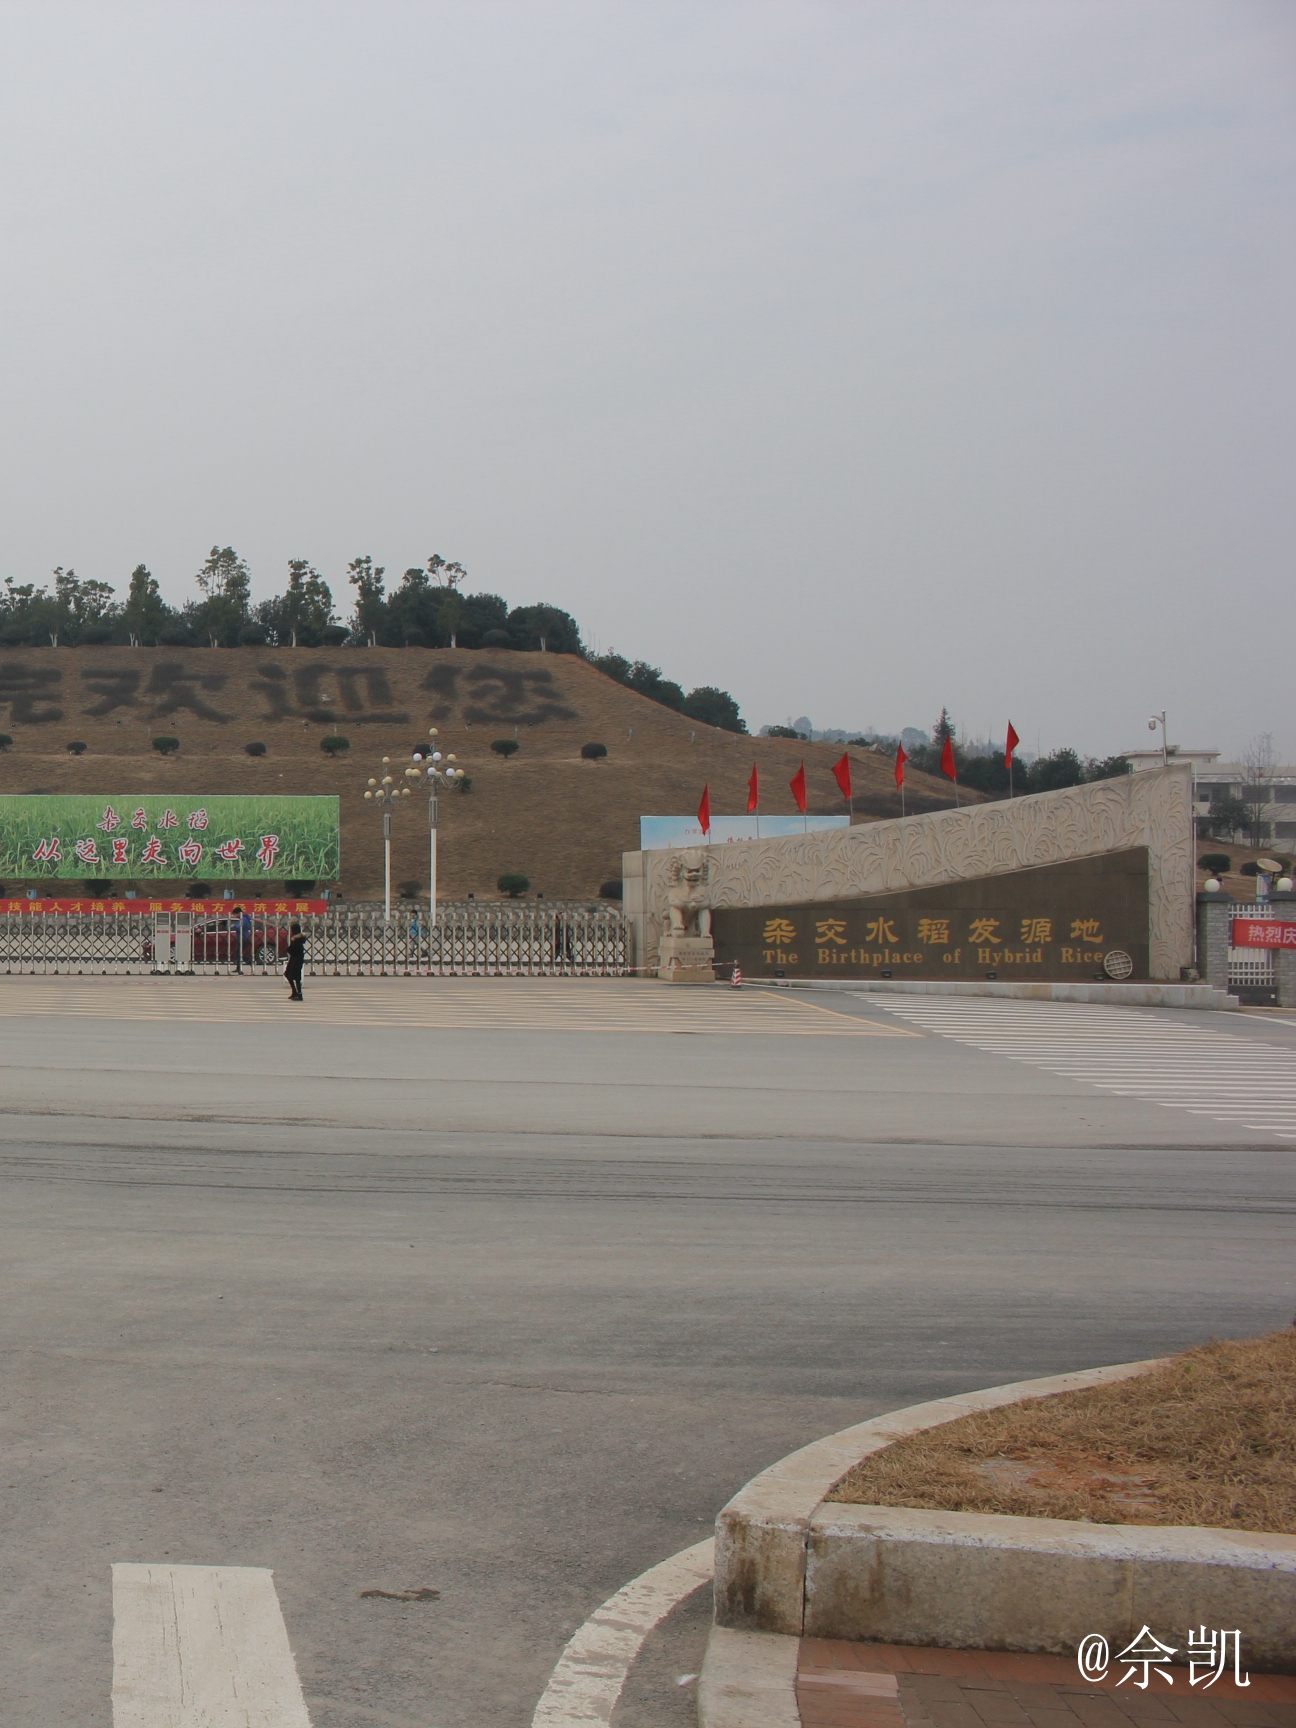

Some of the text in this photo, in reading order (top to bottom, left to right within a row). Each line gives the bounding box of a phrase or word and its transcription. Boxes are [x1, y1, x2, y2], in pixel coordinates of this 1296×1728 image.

[97, 805, 209, 832] 杂交水稻
[32, 835, 279, 871] 从这里走向世界
[149, 902, 309, 912] 服务地方经济发展
[762, 917, 1104, 944] 杂交水稻发源地
[763, 948, 1103, 967] The Birthplace of Hybrid Rice
